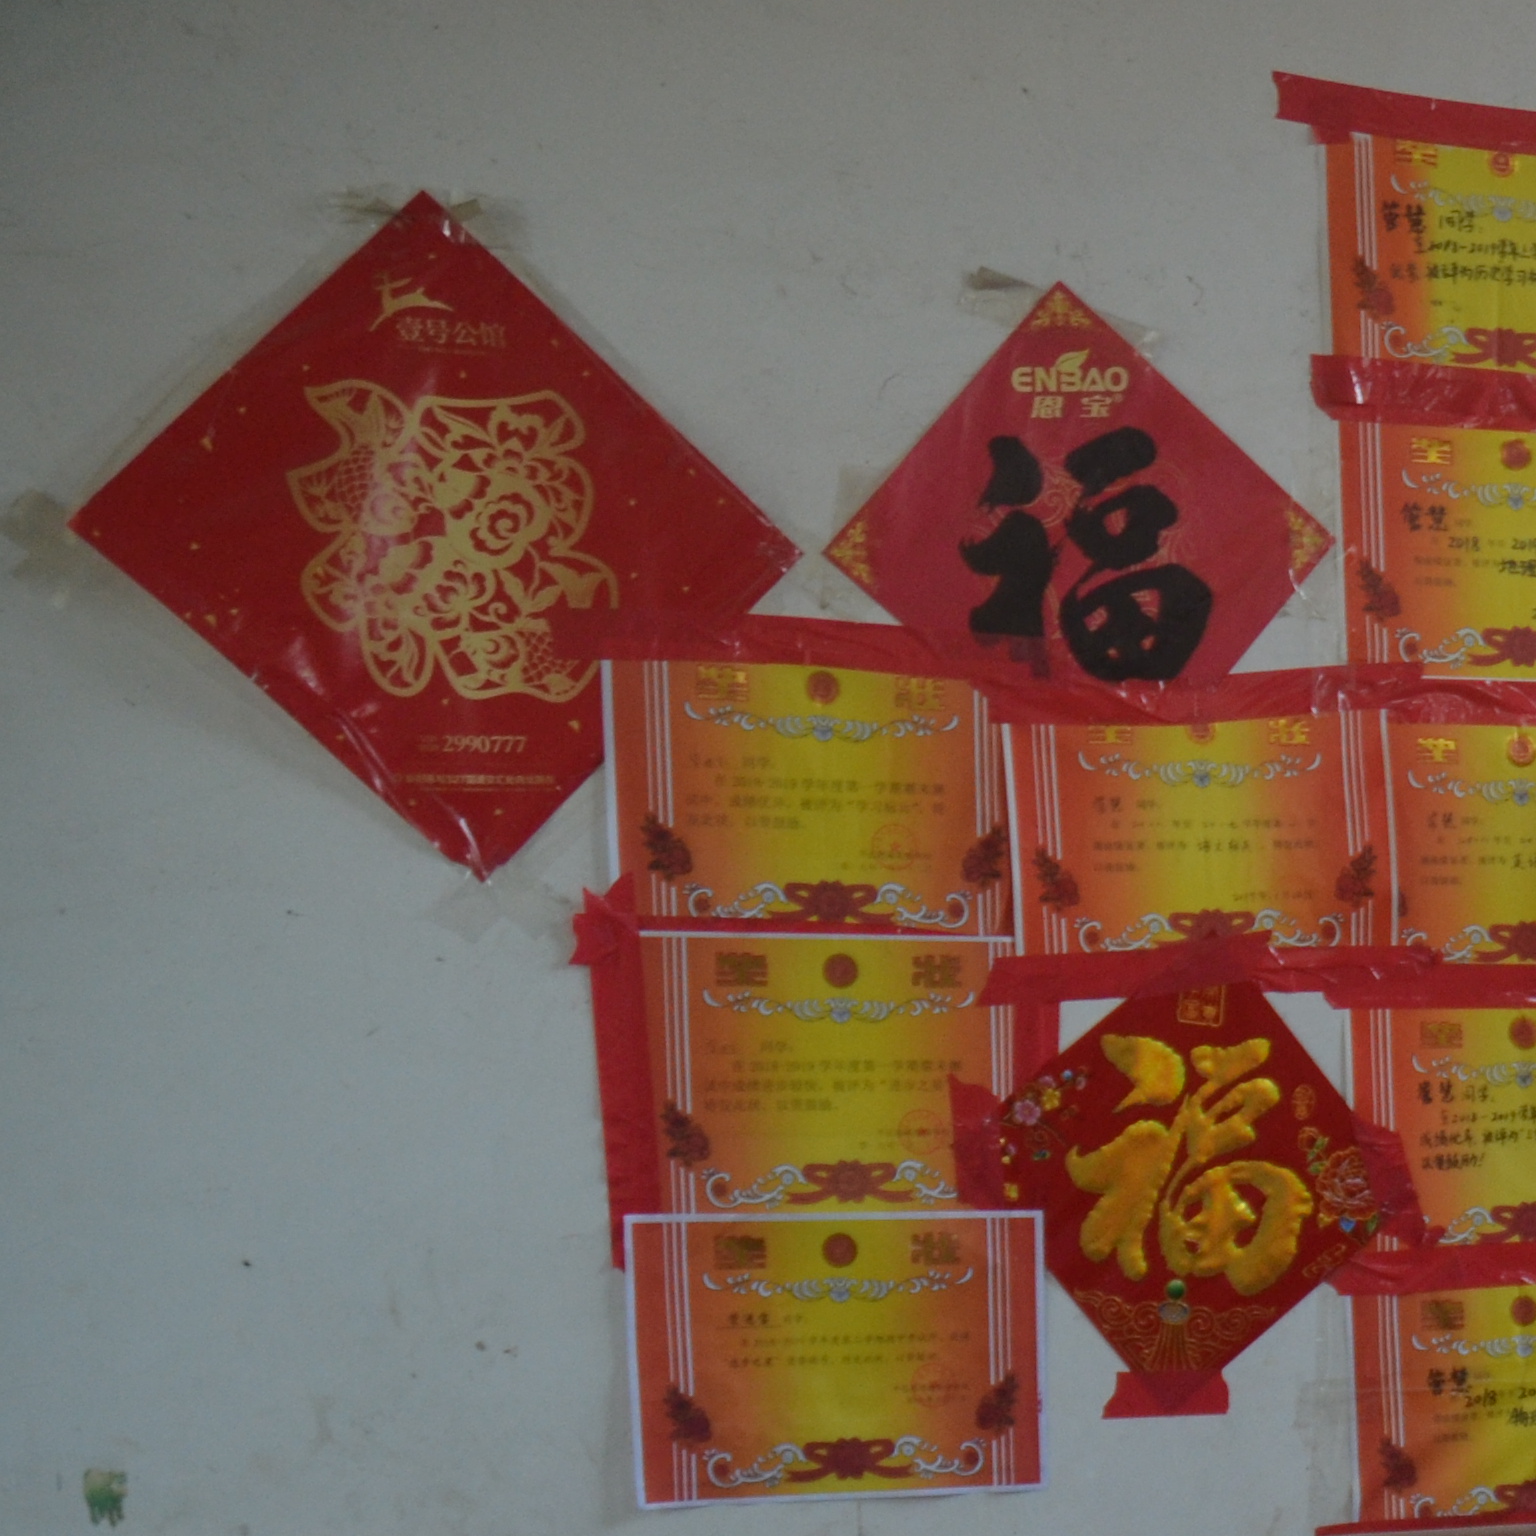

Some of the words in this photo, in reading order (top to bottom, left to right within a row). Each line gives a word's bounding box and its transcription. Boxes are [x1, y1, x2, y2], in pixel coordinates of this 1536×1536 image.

[396, 316, 507, 348] 壹号公馆
[1031, 394, 1112, 419] 恩宝
[959, 426, 1212, 682] 福
[443, 735, 528, 753] 2990777
[1064, 1033, 1313, 1296] 福
[1465, 1389, 1498, 1408] 2018
